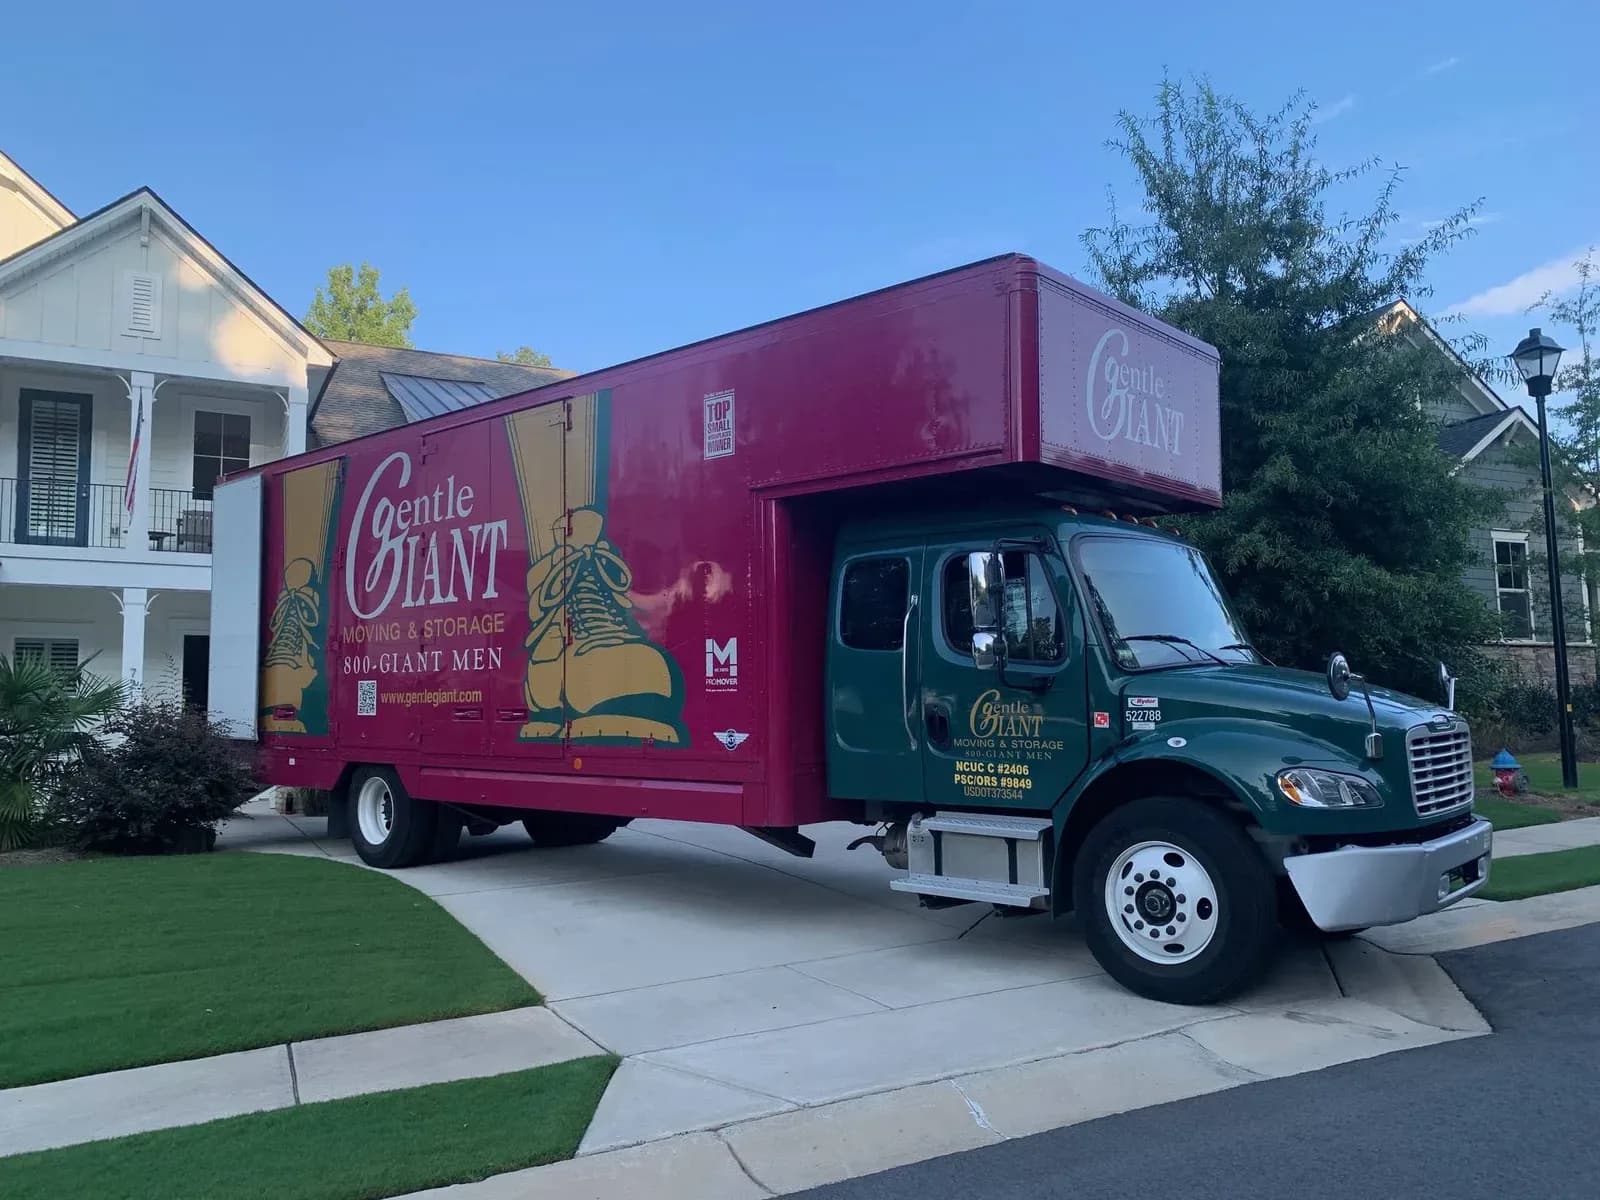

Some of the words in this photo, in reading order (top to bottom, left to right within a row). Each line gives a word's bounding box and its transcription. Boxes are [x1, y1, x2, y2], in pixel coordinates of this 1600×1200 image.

[707, 400, 730, 422] TOP
[707, 419, 730, 434] SMALL
[342, 622, 401, 644] MOVING
[407, 623, 418, 640] &
[423, 612, 505, 639] STORAGE
[343, 650, 443, 675] 800-GIANT
[452, 647, 503, 671] MEN
[1125, 710, 1162, 722] 522788
[953, 738, 996, 748] MOVING
[1000, 738, 1008, 748] &
[1011, 739, 1065, 751] STORAGE
[965, 749, 1021, 760] 800-GIANT
[1026, 751, 1053, 761] MEN
[955, 760, 985, 773] NCUC
[987, 762, 995, 774] C
[997, 763, 1030, 776] #2406
[954, 773, 999, 787] PSC/ORS
[1001, 776, 1033, 790] #9849
[963, 785, 1024, 800] USDOT373544
